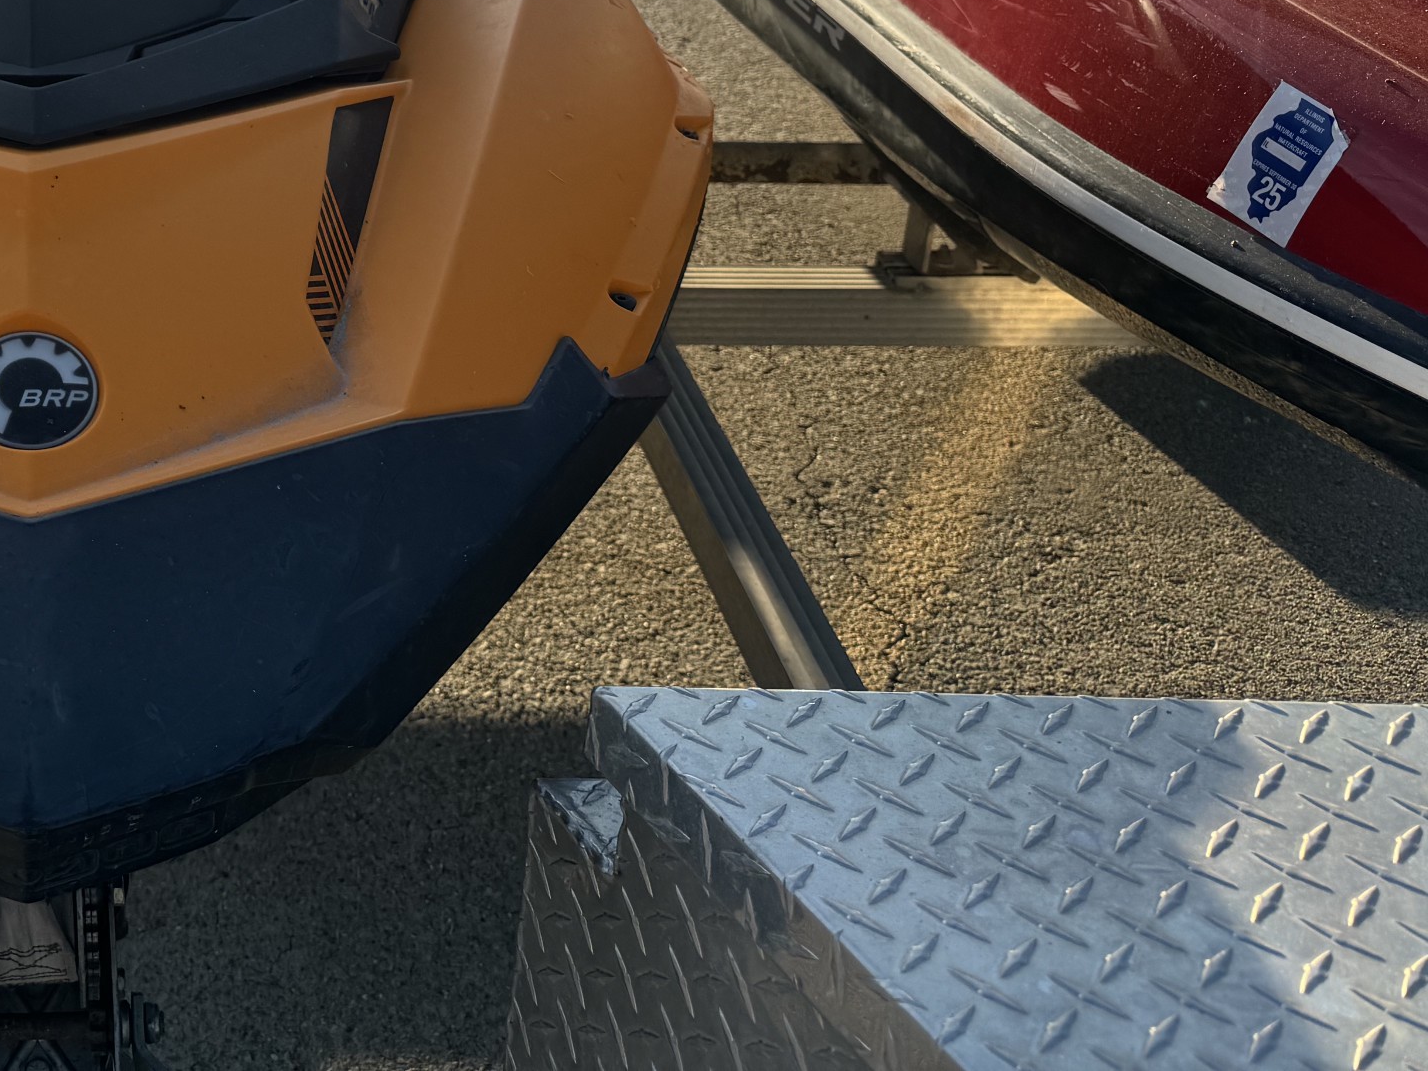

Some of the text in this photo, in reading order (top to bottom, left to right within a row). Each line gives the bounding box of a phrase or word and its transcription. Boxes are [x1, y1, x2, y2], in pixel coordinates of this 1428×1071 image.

[1293, 113, 1325, 133] DEPARTMENT
[1305, 108, 1325, 124] ILLINOIS
[1274, 123, 1323, 156] NATURAL RESOURCES
[1300, 127, 1308, 135] OF
[1262, 139, 1269, 148] IL
[1278, 137, 1308, 158] WATERCRAFT
[1252, 158, 1270, 173] EXPIRES
[1268, 168, 1292, 186] SEPTEMBER
[1251, 176, 1287, 211] 25
[18, 388, 90, 408] BRP
